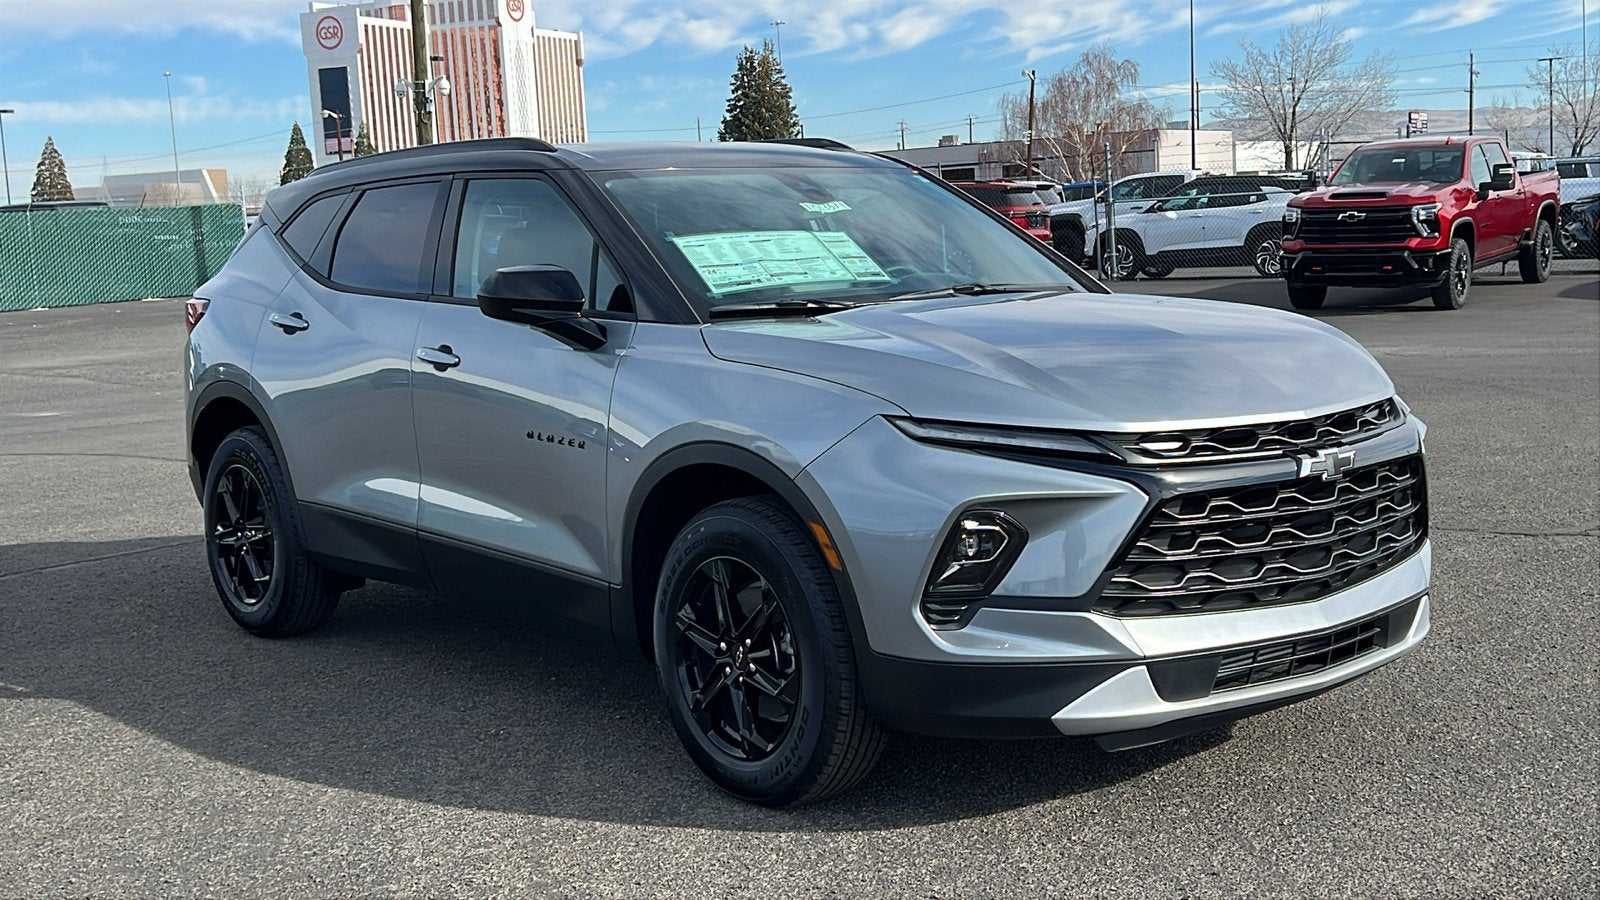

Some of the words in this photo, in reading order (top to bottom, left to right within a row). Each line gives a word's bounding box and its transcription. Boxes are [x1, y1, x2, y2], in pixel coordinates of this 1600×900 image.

[508, 0, 522, 12] GSR
[319, 25, 339, 40] GSR
[526, 430, 586, 450] BLAZER
